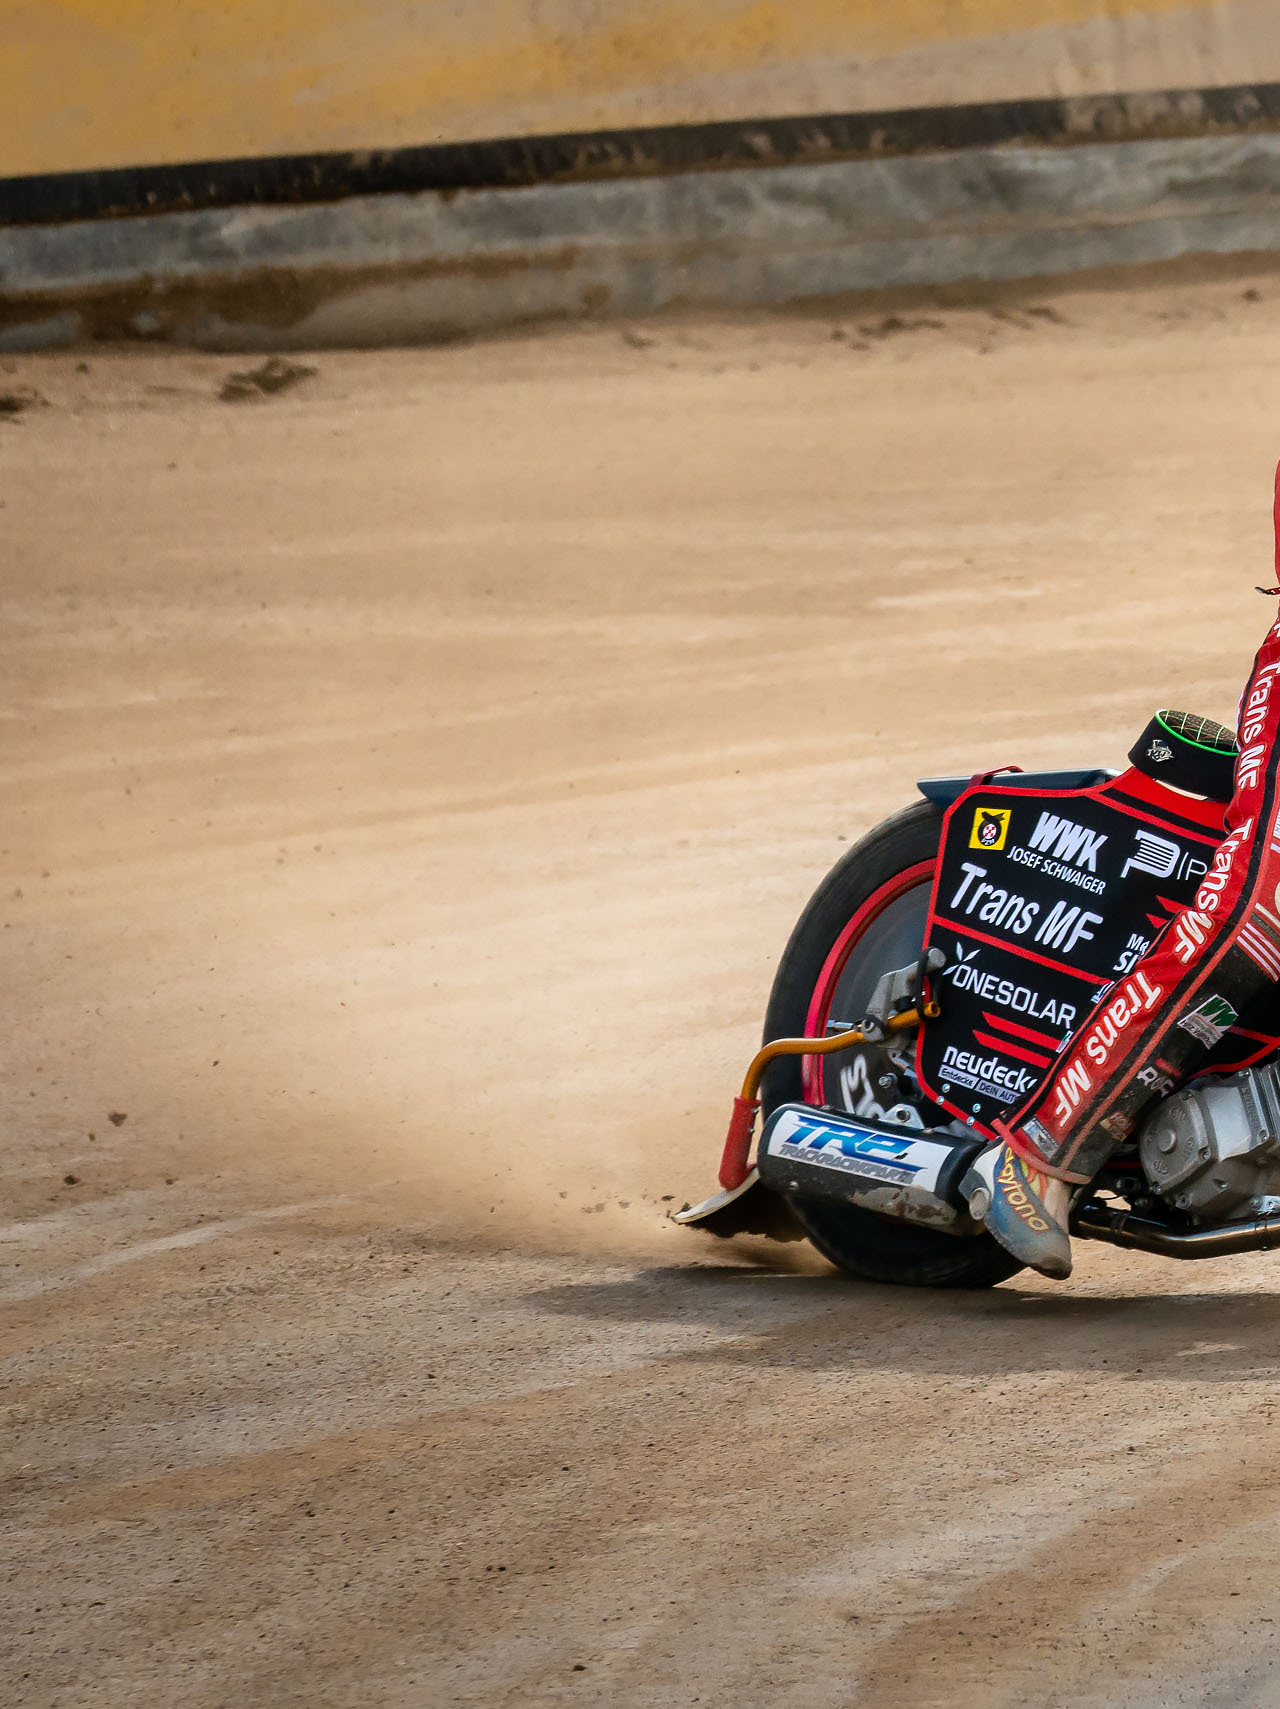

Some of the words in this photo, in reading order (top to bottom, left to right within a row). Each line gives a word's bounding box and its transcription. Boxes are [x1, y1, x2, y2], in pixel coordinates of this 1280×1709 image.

[1238, 744, 1267, 789] MF
[1006, 845, 1042, 873] JOSEF
[1040, 857, 1107, 895] SCHWAIGER
[1027, 811, 1109, 873] WWK
[1196, 818, 1253, 911] Trans
[950, 862, 1040, 935] Trans
[1034, 900, 1104, 954] MF
[1174, 910, 1214, 964] MF
[951, 962, 1077, 1030] ONESOLAR
[1086, 971, 1162, 1065] Trans
[942, 1045, 1038, 1094] neudeck
[980, 1081, 999, 1097] DEIN
[999, 1091, 1017, 1102] AUT
[1056, 1059, 1092, 1127] MF
